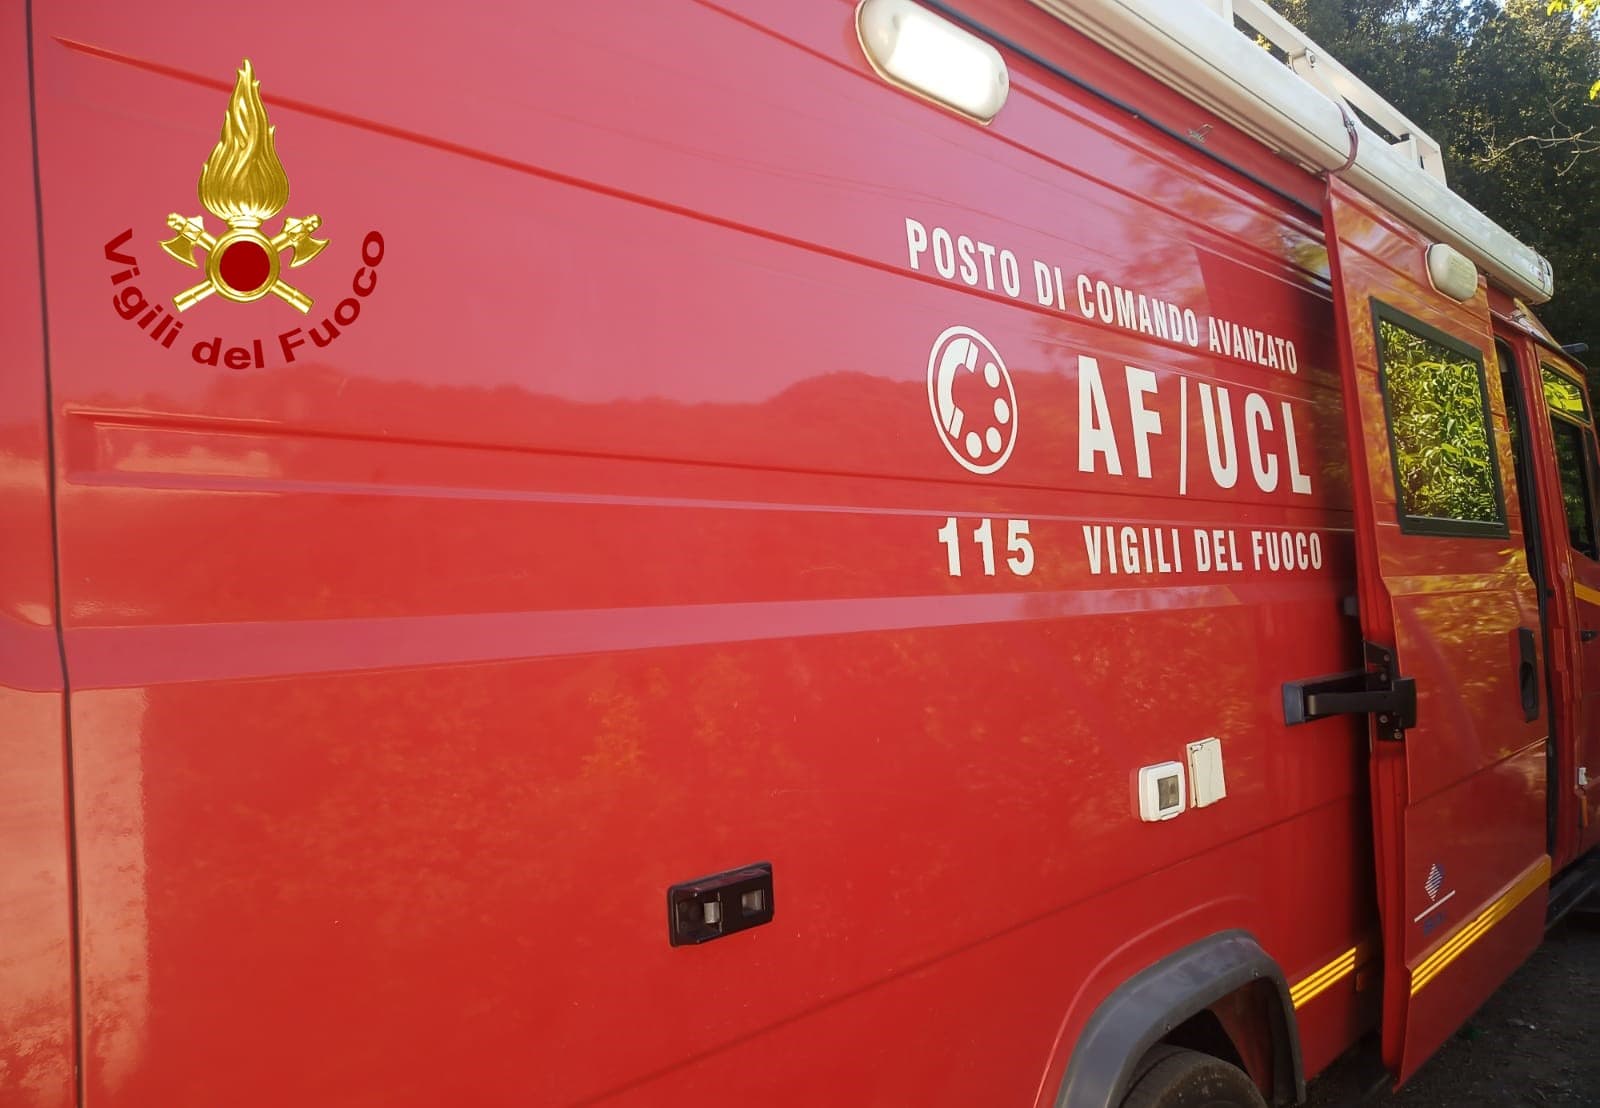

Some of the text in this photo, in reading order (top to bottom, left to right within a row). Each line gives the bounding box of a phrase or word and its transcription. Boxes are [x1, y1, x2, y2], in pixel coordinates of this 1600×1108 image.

[904, 217, 1298, 375] POSTO DI COMANDO AVANZATO
[1078, 354, 1312, 496] AF/UCL
[938, 517, 1322, 577] 115 VIGILI DEL FUOCO
